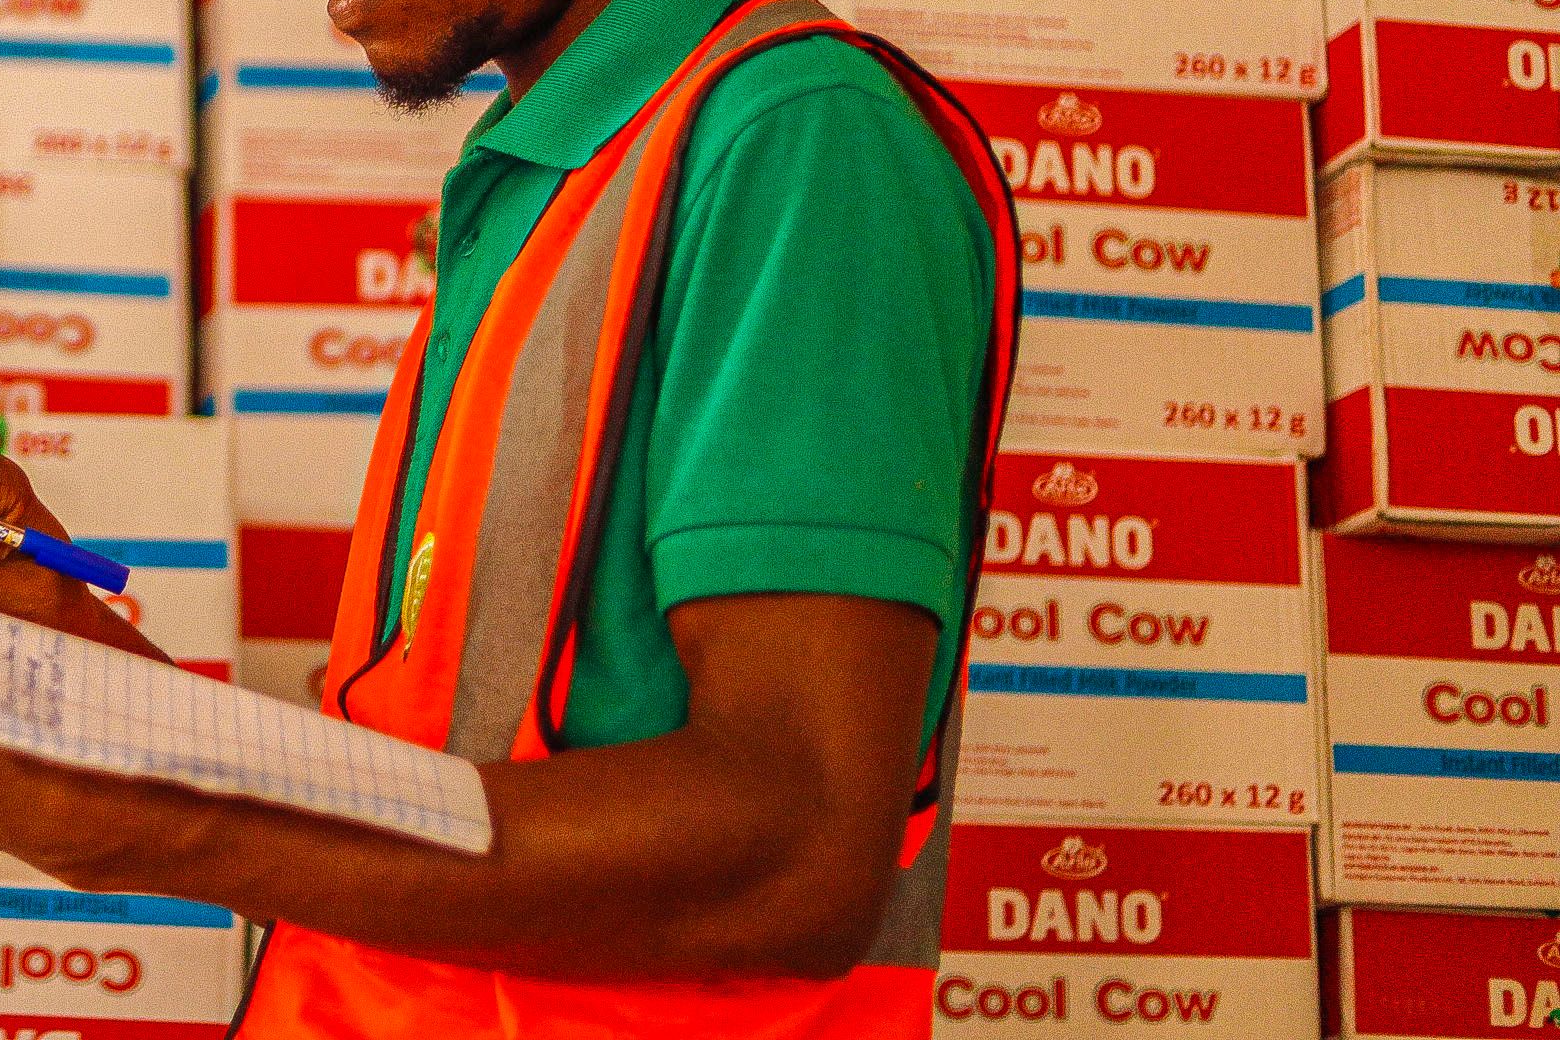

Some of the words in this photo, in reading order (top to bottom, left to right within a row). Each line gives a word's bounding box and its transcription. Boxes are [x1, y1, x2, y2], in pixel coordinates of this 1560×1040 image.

[1175, 54, 1226, 78] 260
[1260, 58, 1292, 83] 12
[1299, 65, 1316, 88] g
[991, 138, 1155, 198] DANO
[1091, 229, 1210, 273] Cow
[1164, 402, 1216, 428] 260
[1250, 407, 1282, 431] 12
[1289, 414, 1306, 437] g
[984, 512, 1153, 569] DANO
[972, 599, 1060, 642] ool
[1087, 602, 1209, 646] Cow
[1470, 601, 1560, 652] DA
[1423, 682, 1548, 727] Cool
[1158, 780, 1213, 807] 260
[1248, 784, 1281, 809] 12
[1288, 790, 1305, 814] g
[988, 888, 1162, 944] DANO
[0, 945, 143, 994] Cool
[935, 976, 1067, 1021] Cool
[1094, 978, 1218, 1024] Cow
[1488, 977, 1560, 1028] DA
